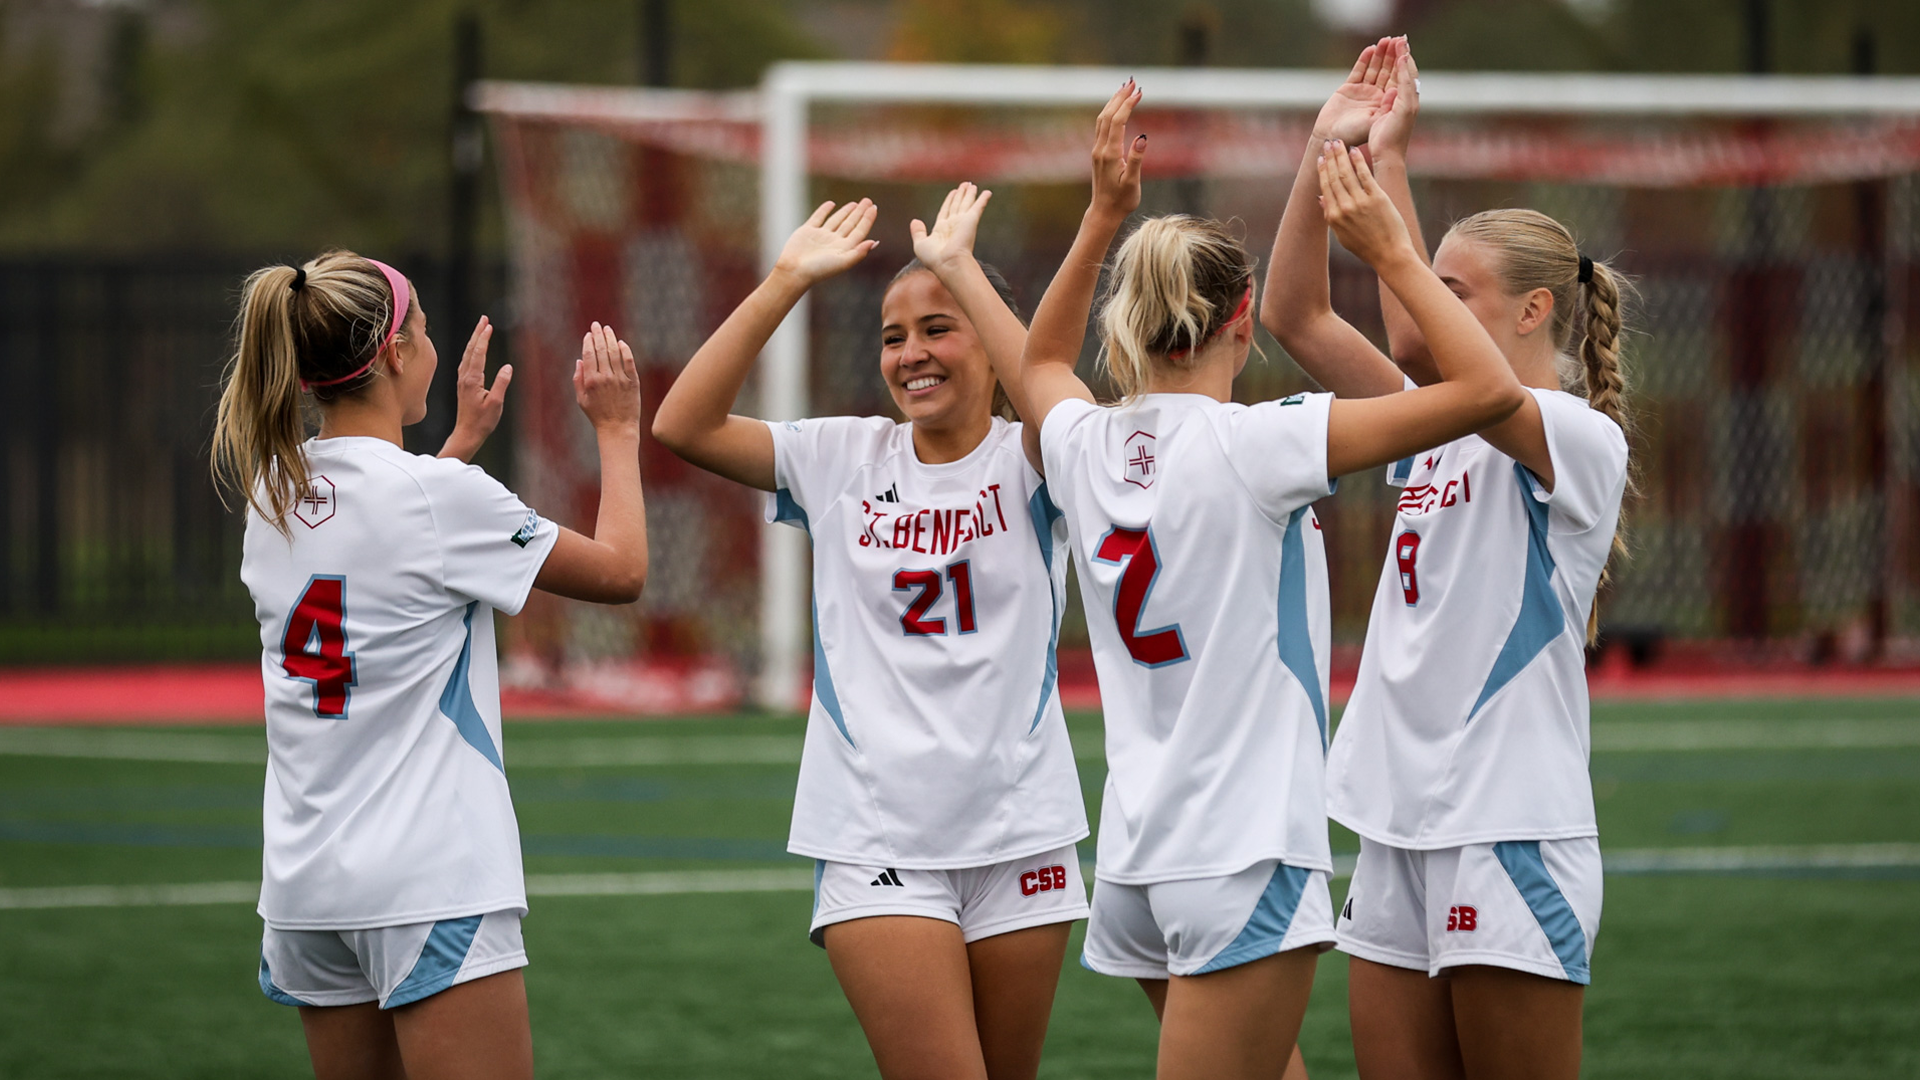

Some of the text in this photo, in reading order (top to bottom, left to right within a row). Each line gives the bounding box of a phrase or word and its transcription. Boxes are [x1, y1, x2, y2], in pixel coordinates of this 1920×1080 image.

[280, 573, 358, 721] 4
[891, 558, 979, 637] 21
[1090, 523, 1191, 670] 2
[1018, 864, 1067, 898] CSB
